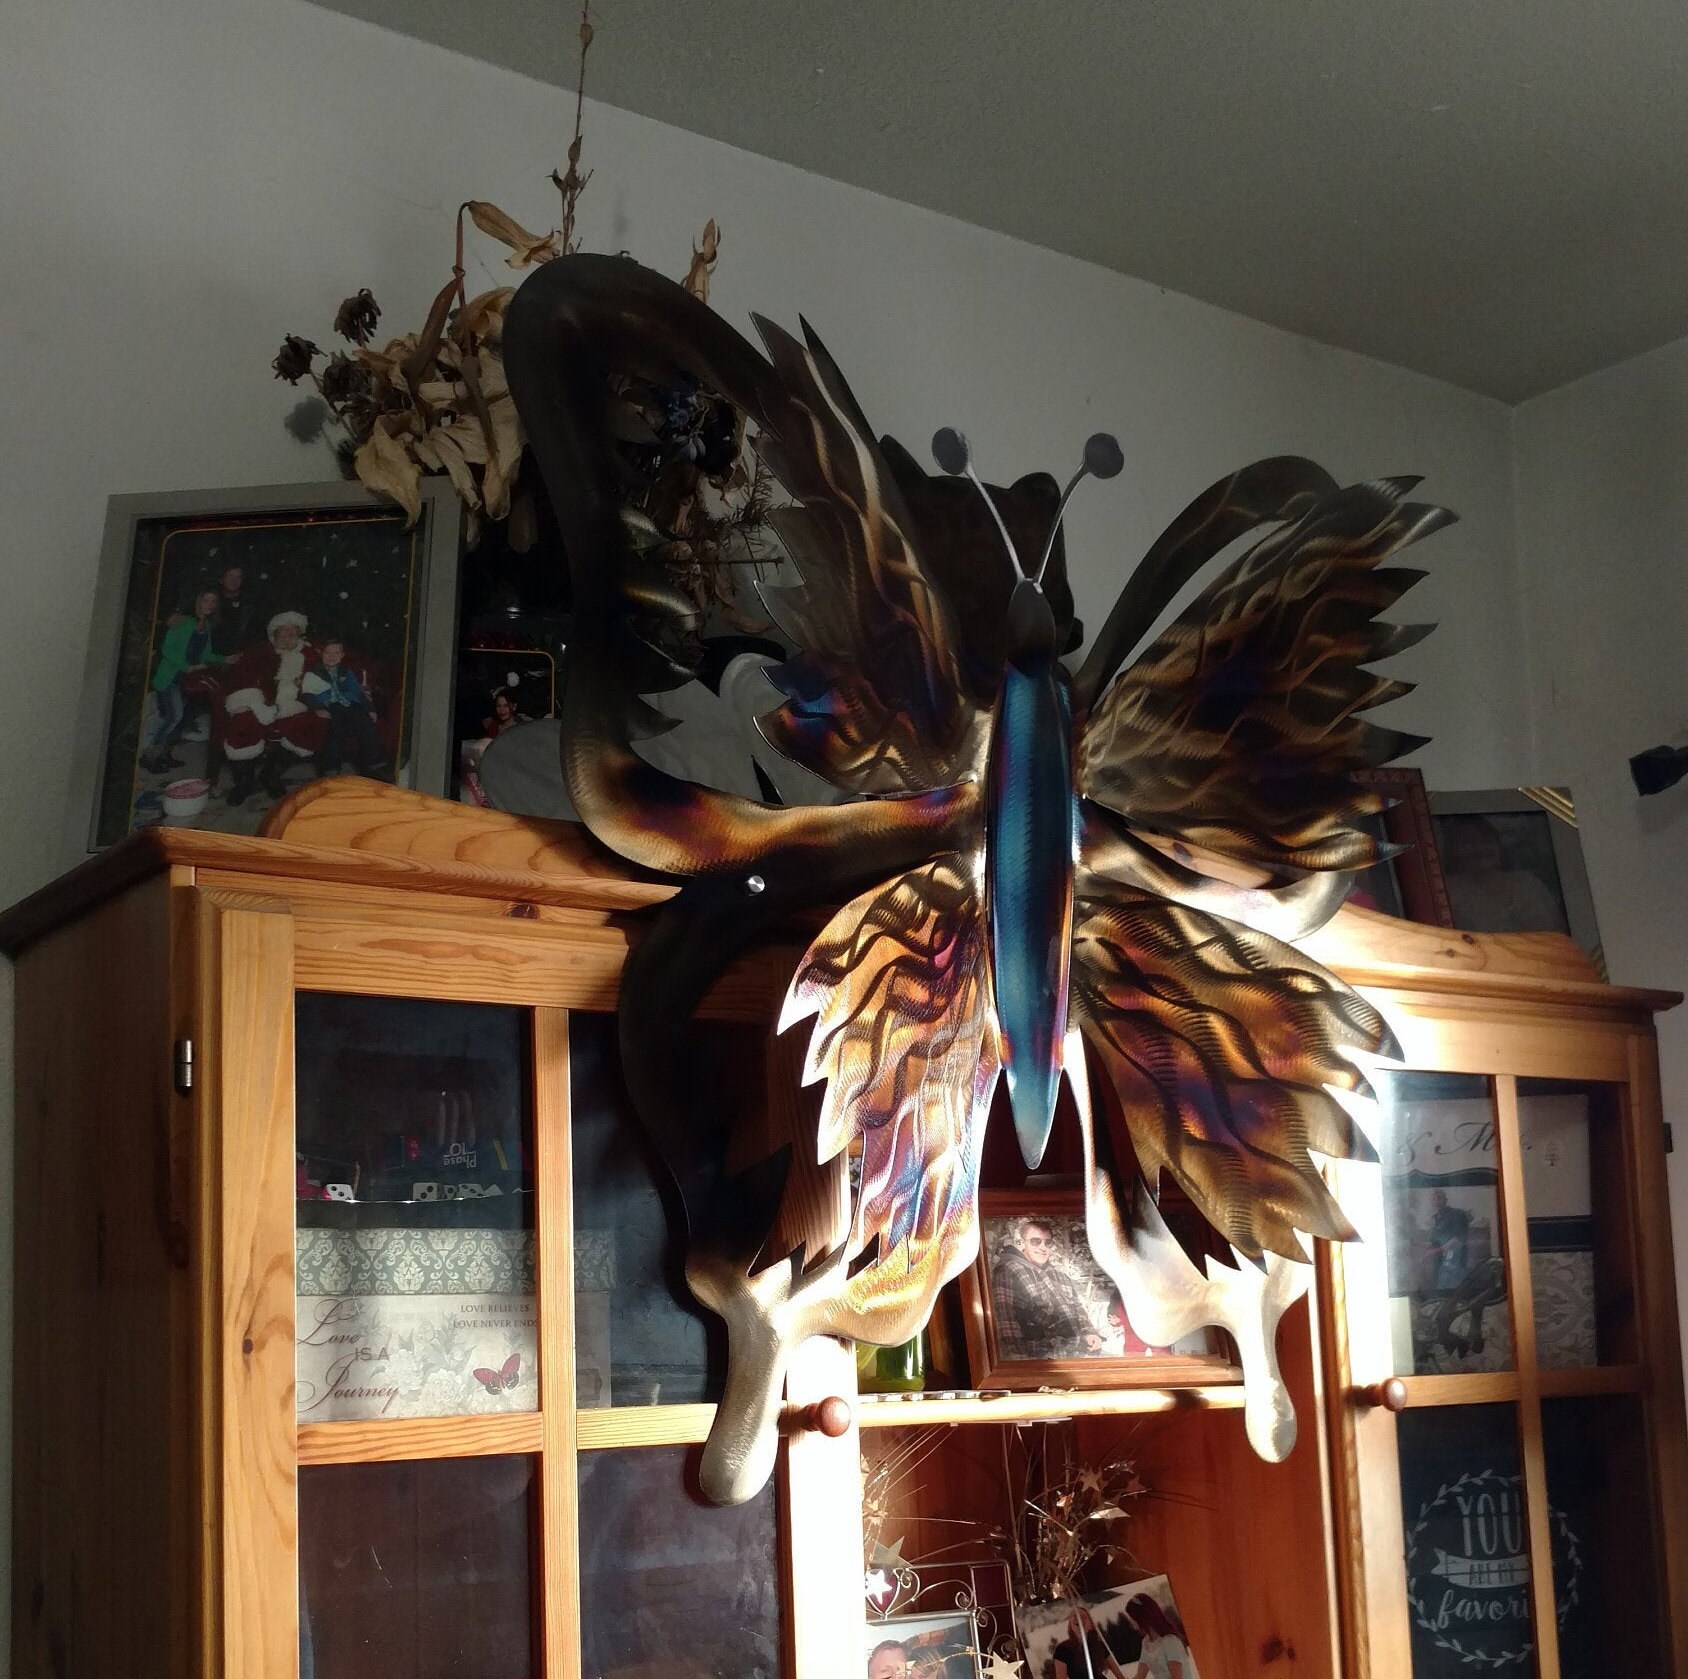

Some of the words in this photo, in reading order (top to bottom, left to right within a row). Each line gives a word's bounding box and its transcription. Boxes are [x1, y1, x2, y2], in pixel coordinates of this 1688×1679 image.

[443, 1154, 477, 1168] Phase
[297, 1297, 361, 1346] Love
[460, 1304, 484, 1313] LOVE
[488, 1303, 530, 1313] BELIEVES
[453, 1319, 479, 1328] LOVE
[480, 1319, 512, 1328] NEVER
[355, 1347, 371, 1361] IS
[378, 1347, 390, 1361] A
[297, 1352, 400, 1414] Journey
[1456, 1491, 1522, 1557] YOU
[1437, 1589, 1530, 1629] favori
